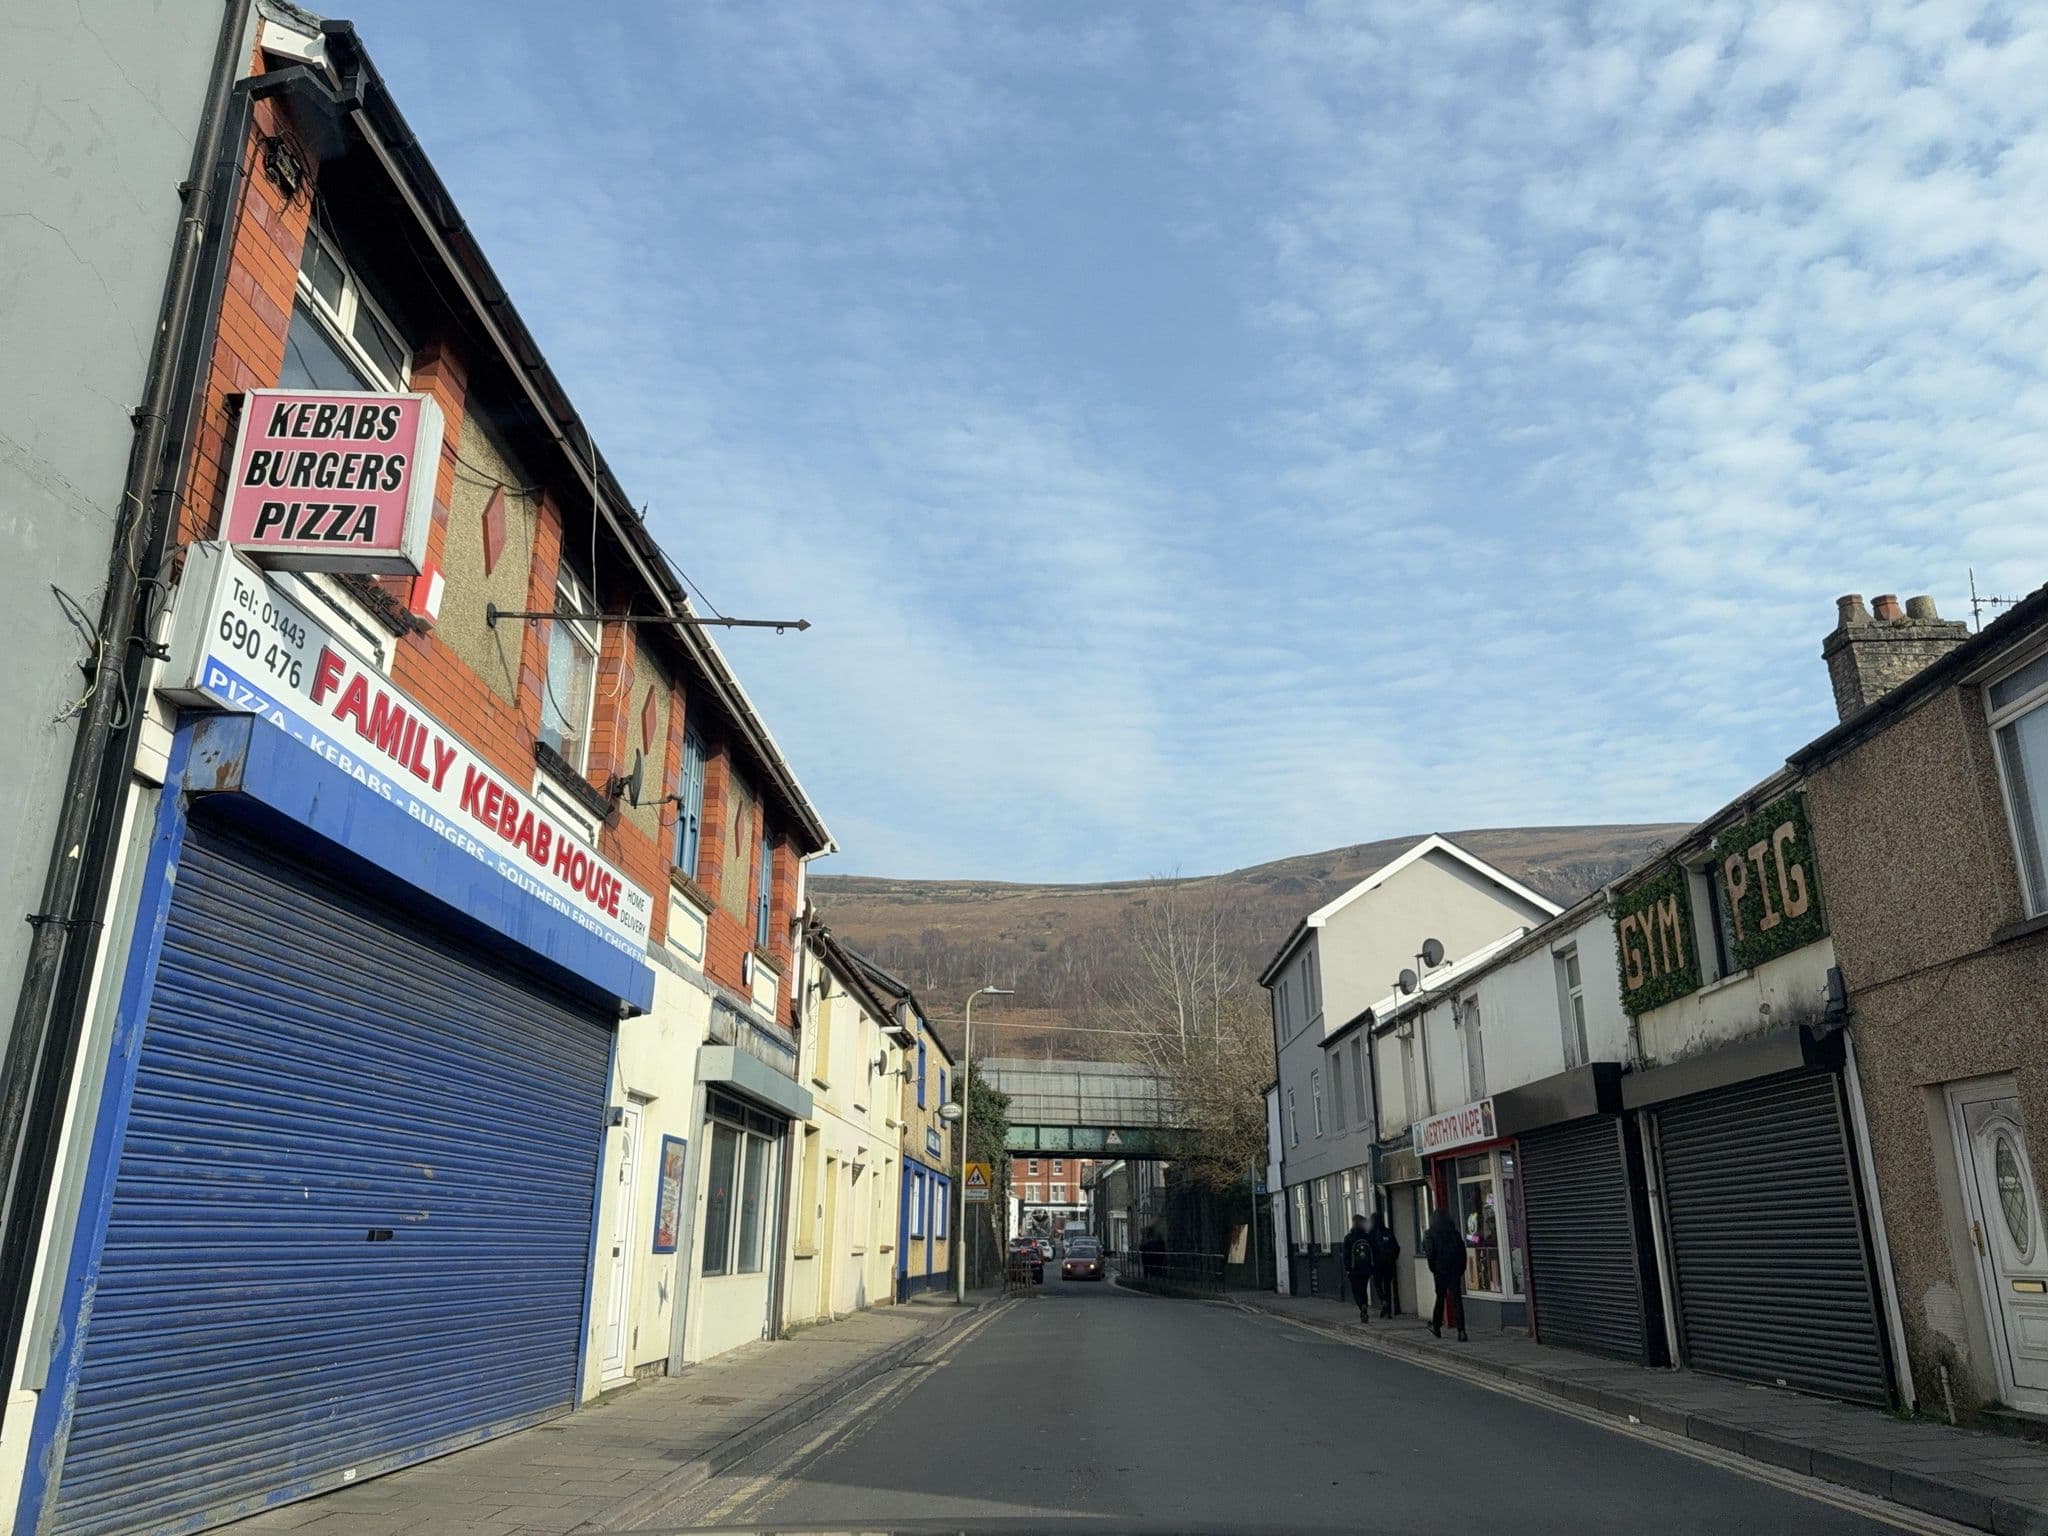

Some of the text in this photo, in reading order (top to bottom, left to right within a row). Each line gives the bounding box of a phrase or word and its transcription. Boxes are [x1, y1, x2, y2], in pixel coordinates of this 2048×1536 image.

[266, 402, 402, 442] KEBABS
[242, 450, 406, 492] BURGERS
[251, 501, 378, 544] PIZZA
[233, 577, 306, 650] Tel: 01443
[220, 610, 303, 689] 690 476
[208, 667, 288, 730] PIZZA
[310, 734, 393, 801] KEBABS
[408, 799, 485, 862] BURGERS
[497, 861, 570, 916] SOUTHERN
[572, 910, 603, 936] FRIED
[310, 644, 622, 919] FAMILY KEBAB HOUSE
[627, 888, 646, 913] HOME
[1620, 820, 1809, 990] GYM PIG
[620, 909, 647, 937] DELIVERY
[1423, 1108, 1482, 1149] MERTHYR VAPE
